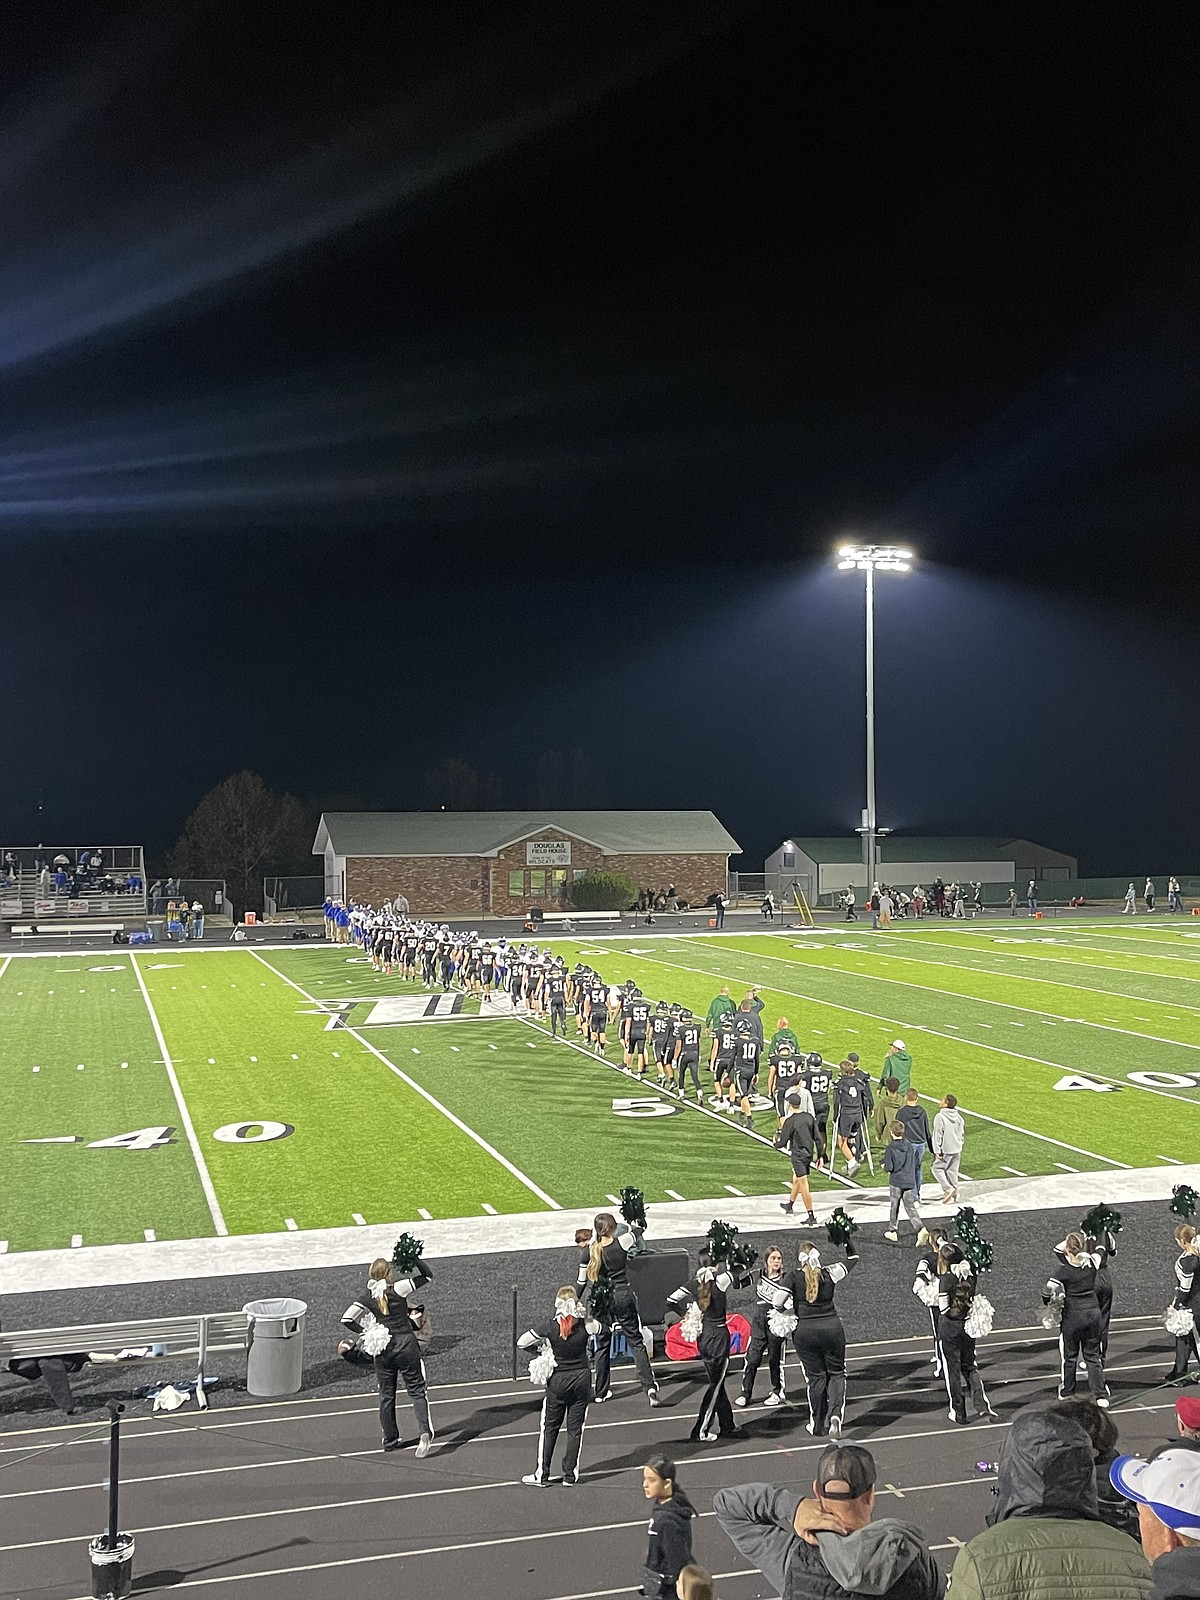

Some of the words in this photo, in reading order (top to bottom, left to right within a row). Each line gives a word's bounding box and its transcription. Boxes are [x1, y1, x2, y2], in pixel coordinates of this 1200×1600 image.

[407, 938, 418, 948] 50
[425, 941, 436, 951] 20
[482, 955, 493, 965] 66
[552, 979, 563, 992] 31
[591, 990, 604, 1003] 54
[633, 1007, 647, 1021] 55
[685, 1029, 698, 1044] 21
[743, 1043, 756, 1059] 10
[778, 1060, 795, 1077] 63
[811, 1075, 828, 1093] 62
[848, 1087, 857, 1097] 4
